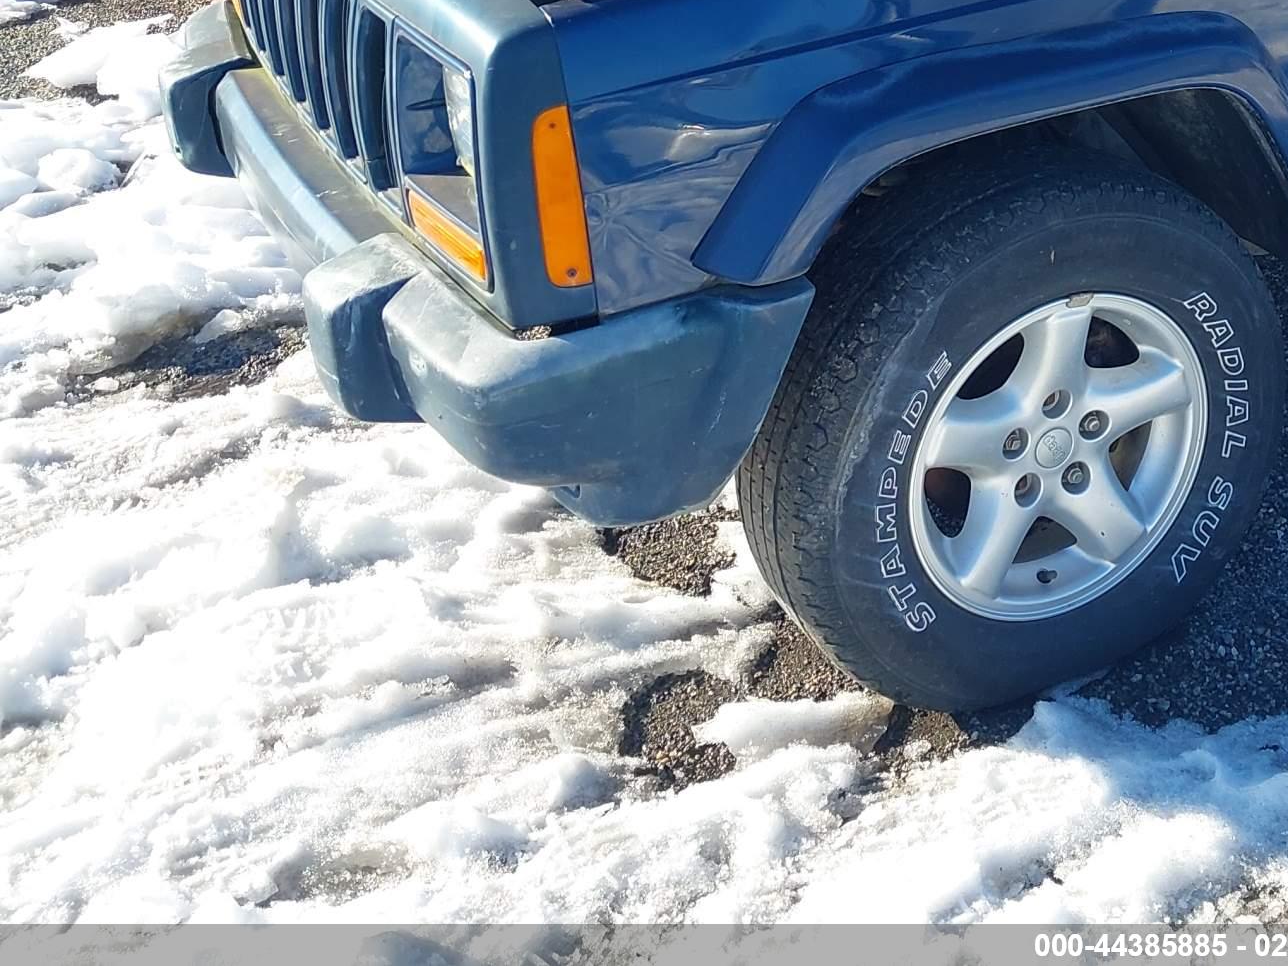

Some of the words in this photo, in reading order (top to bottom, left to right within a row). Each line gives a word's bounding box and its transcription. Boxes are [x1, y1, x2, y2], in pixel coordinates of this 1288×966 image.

[1183, 291, 1250, 459] RADIAL
[875, 350, 954, 633] STAMPEDE
[1172, 475, 1234, 584] SUV
